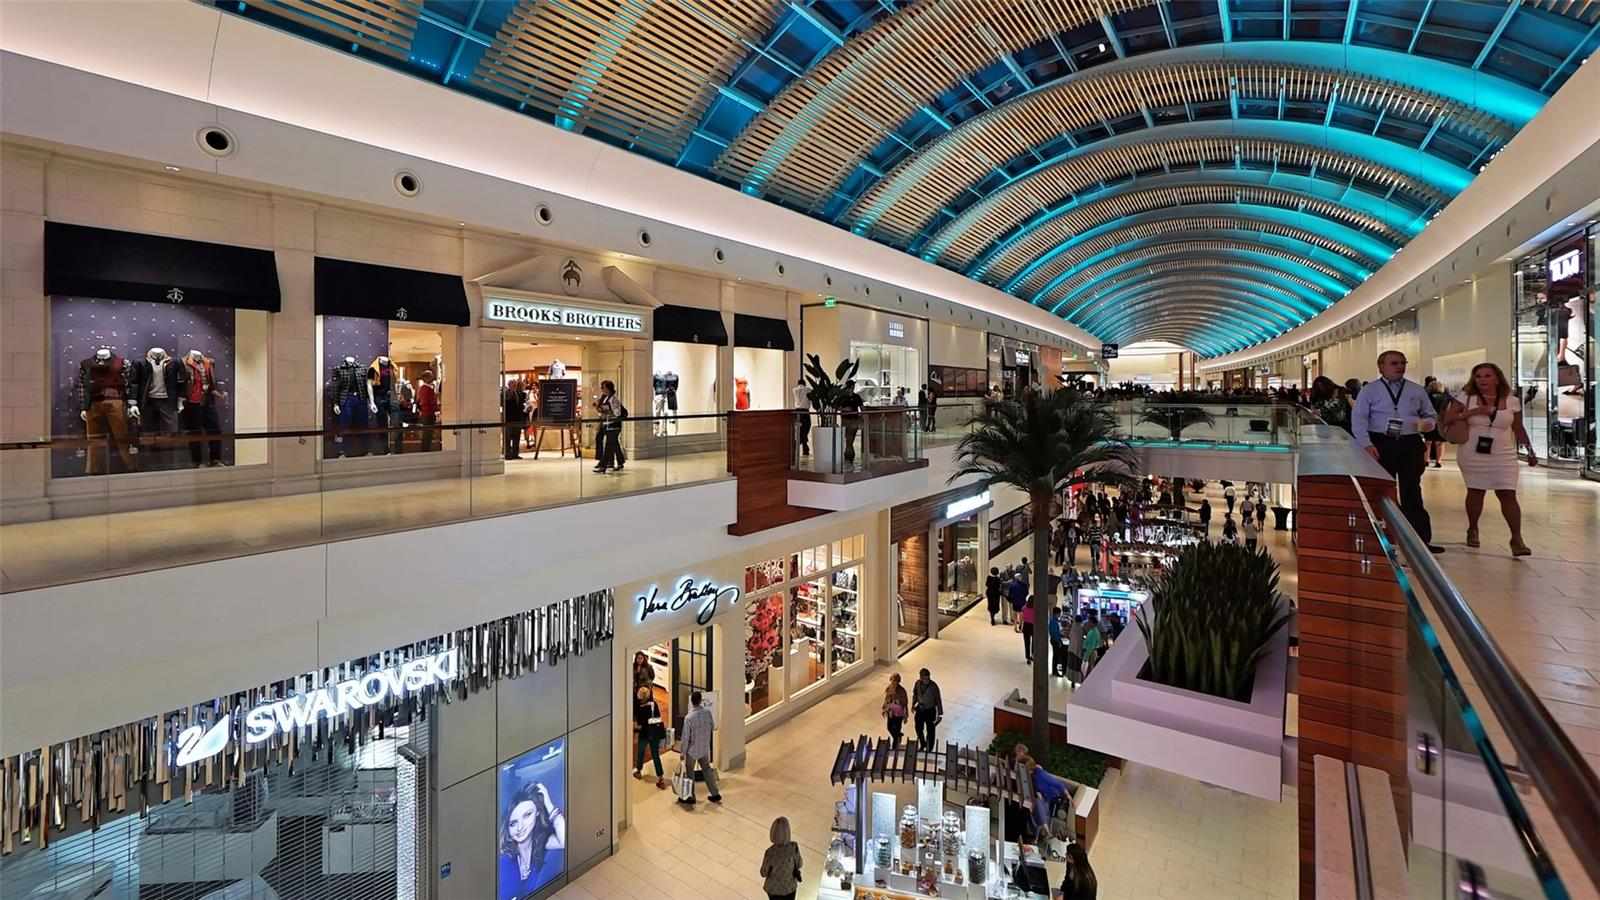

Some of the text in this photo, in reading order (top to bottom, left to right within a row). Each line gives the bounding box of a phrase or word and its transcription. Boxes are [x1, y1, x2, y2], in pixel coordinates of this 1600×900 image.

[493, 304, 642, 330] BROOKS BROTHERS
[638, 578, 740, 625] Vera Bradley
[245, 648, 459, 744] SWAROVSKI
